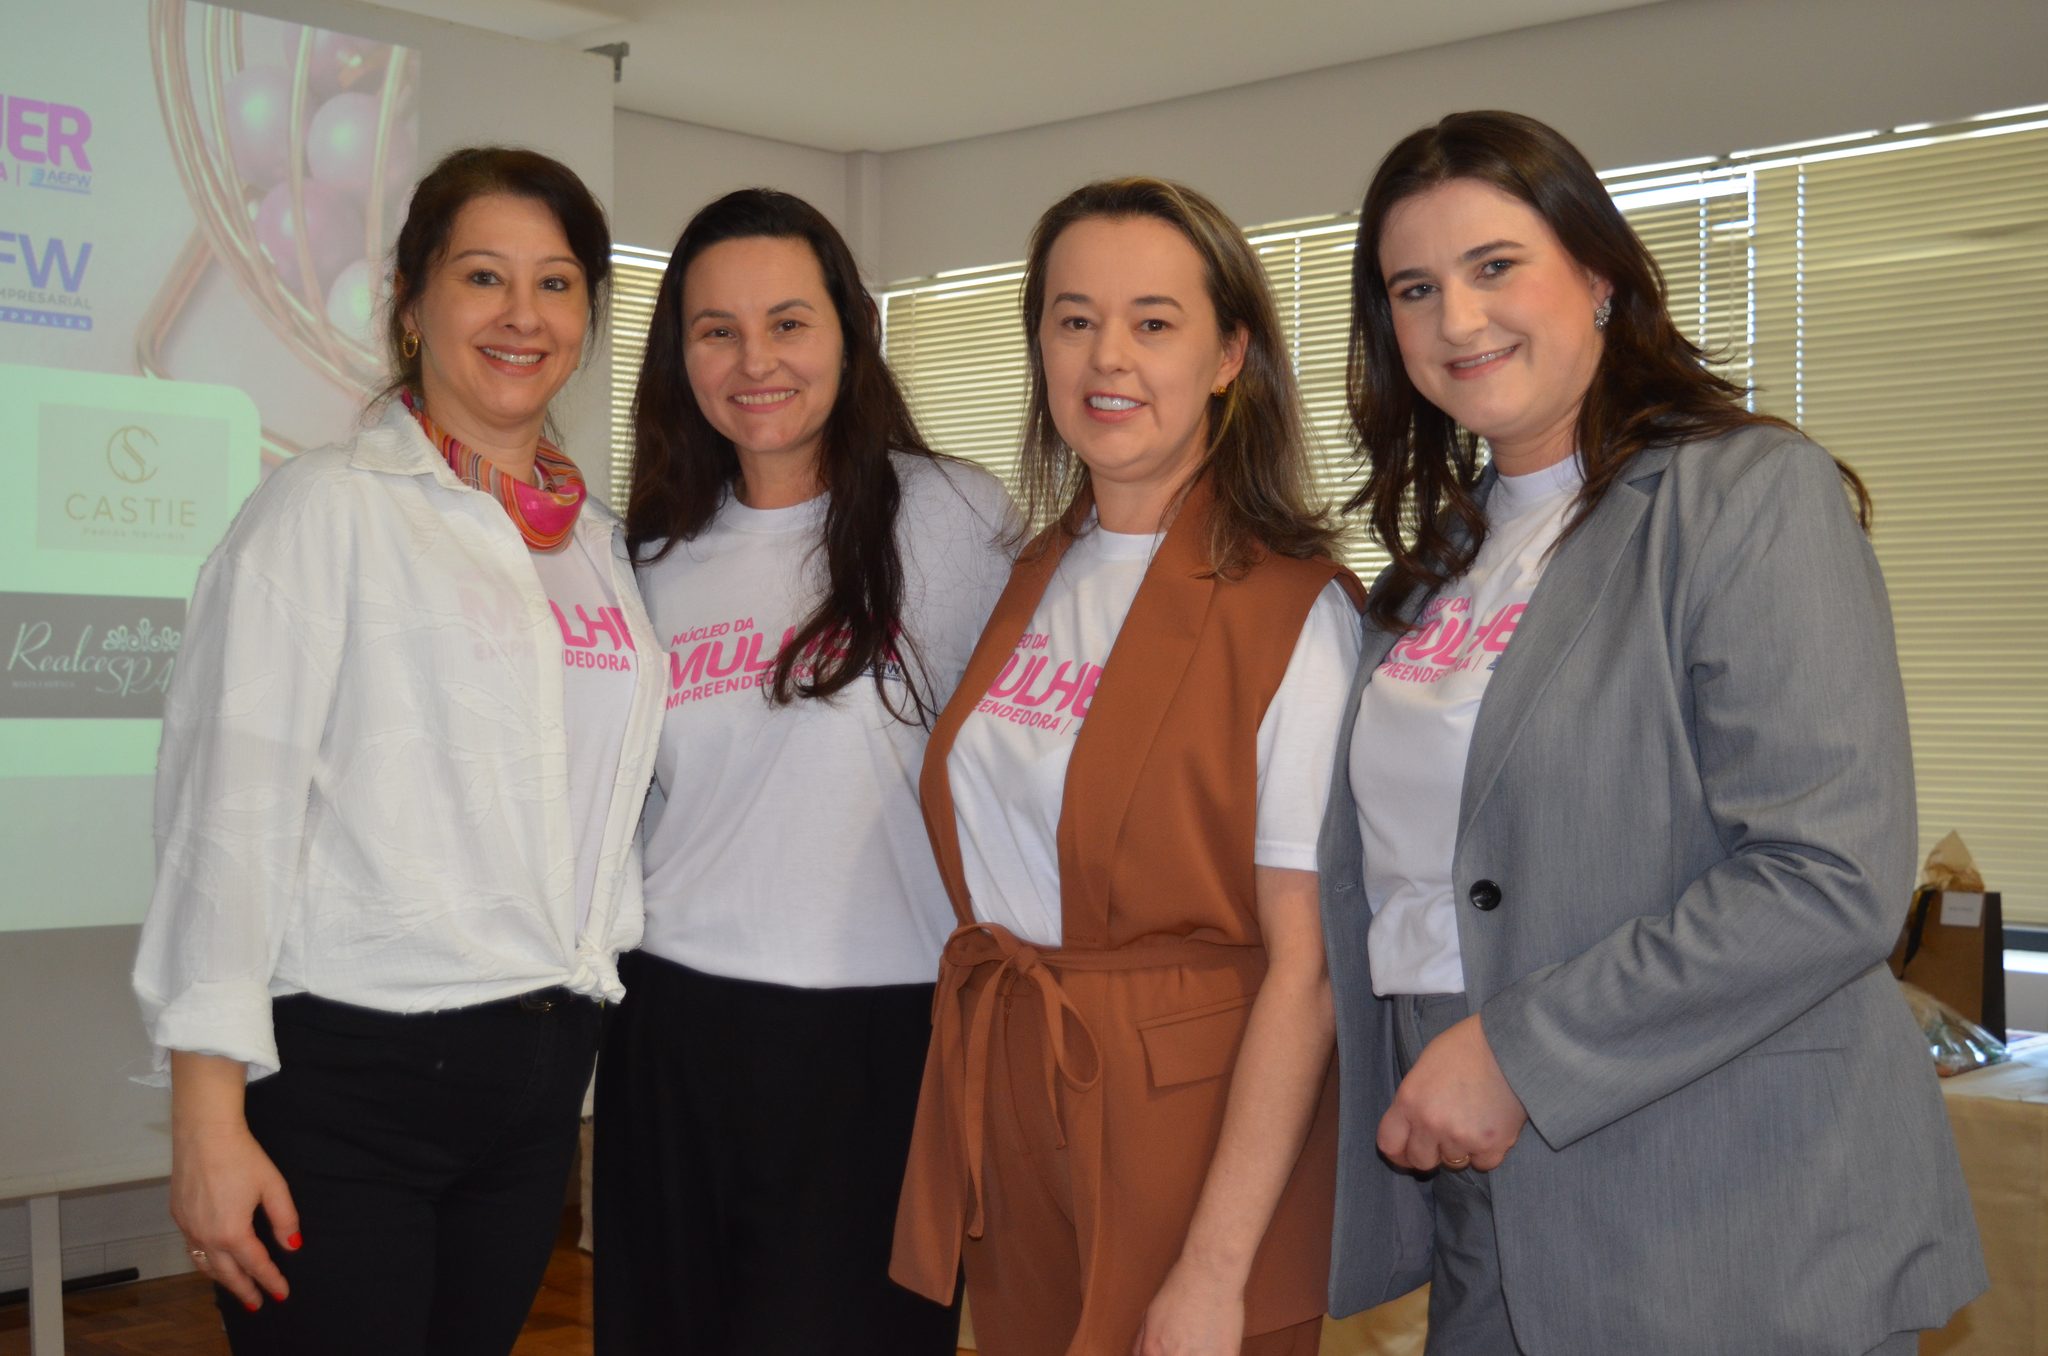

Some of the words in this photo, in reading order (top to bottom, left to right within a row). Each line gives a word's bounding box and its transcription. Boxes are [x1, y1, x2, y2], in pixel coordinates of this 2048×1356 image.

[0, 93, 93, 172] ER
[65, 492, 197, 527] CASTIE
[7, 621, 108, 673] Realce
[670, 622, 730, 648] NÚCLEO
[733, 617, 754, 633] DA
[1032, 632, 1050, 650] DA
